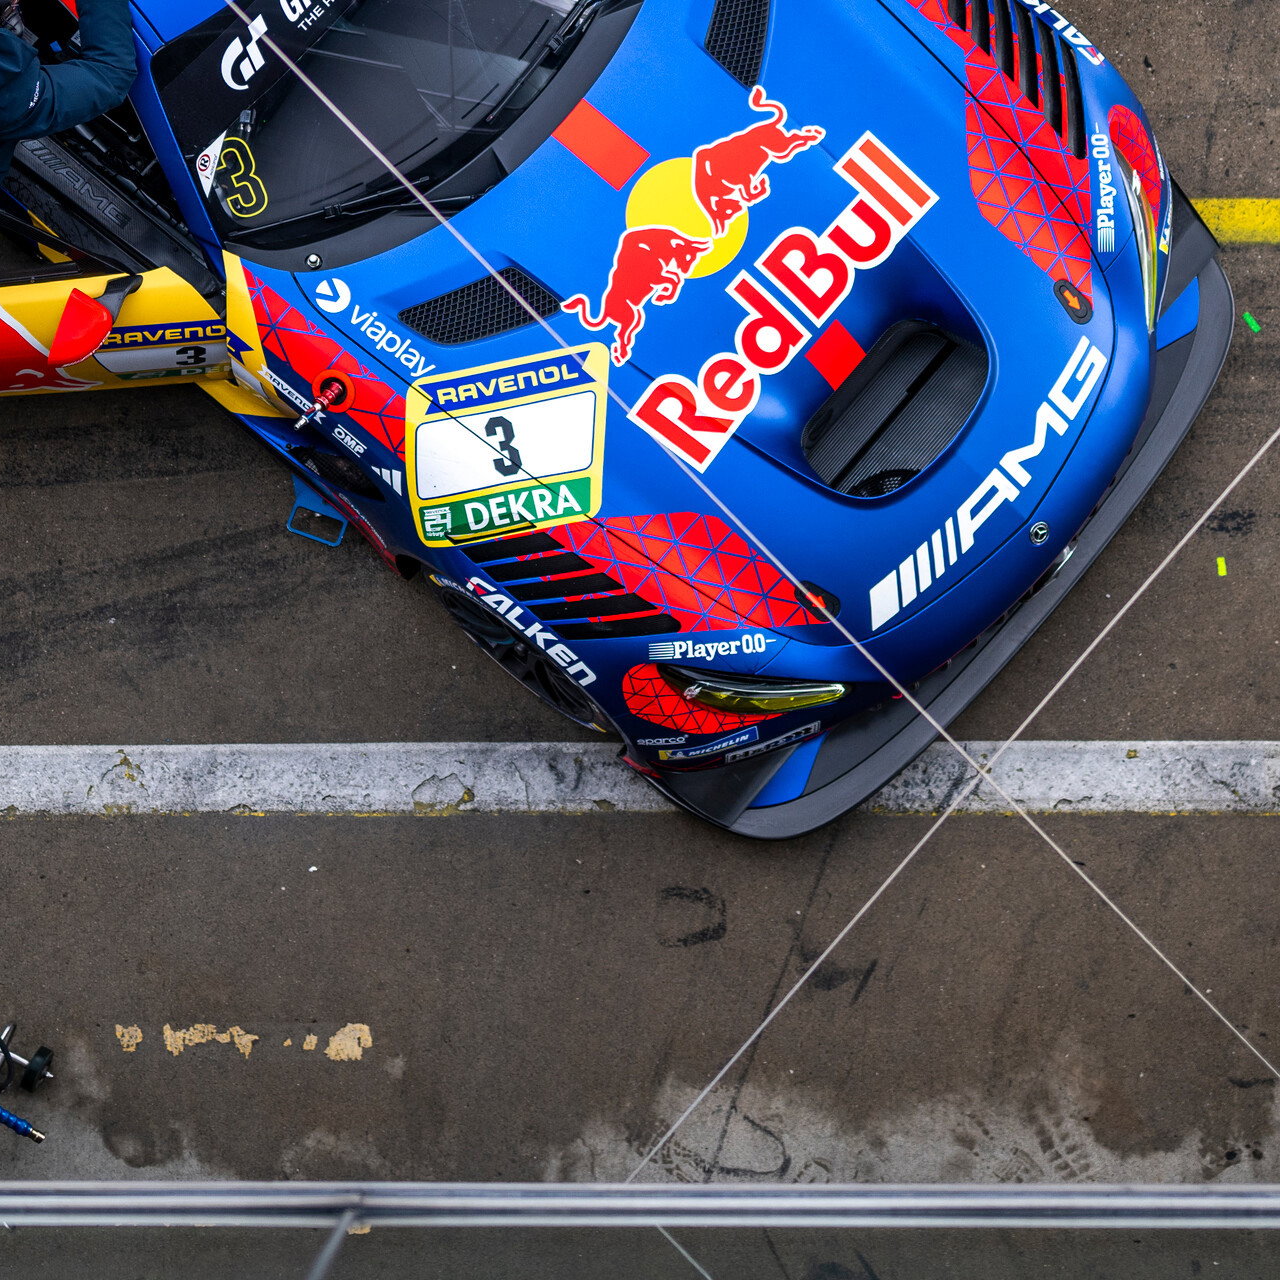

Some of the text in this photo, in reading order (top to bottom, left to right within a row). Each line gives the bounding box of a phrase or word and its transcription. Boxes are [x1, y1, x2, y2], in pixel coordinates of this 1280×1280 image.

[297, 7, 326, 32] THE
[215, 137, 268, 218] 3
[1097, 160, 1117, 229] Player
[176, 346, 207, 366] 3
[350, 304, 436, 378] viaplay
[436, 363, 580, 405] RAVENOL
[333, 426, 366, 456] OMP
[485, 415, 523, 477] 3
[464, 484, 582, 531] DEKRA
[466, 576, 597, 687] FALKEN
[673, 640, 740, 661] Player
[688, 733, 750, 757] MICHELIN
